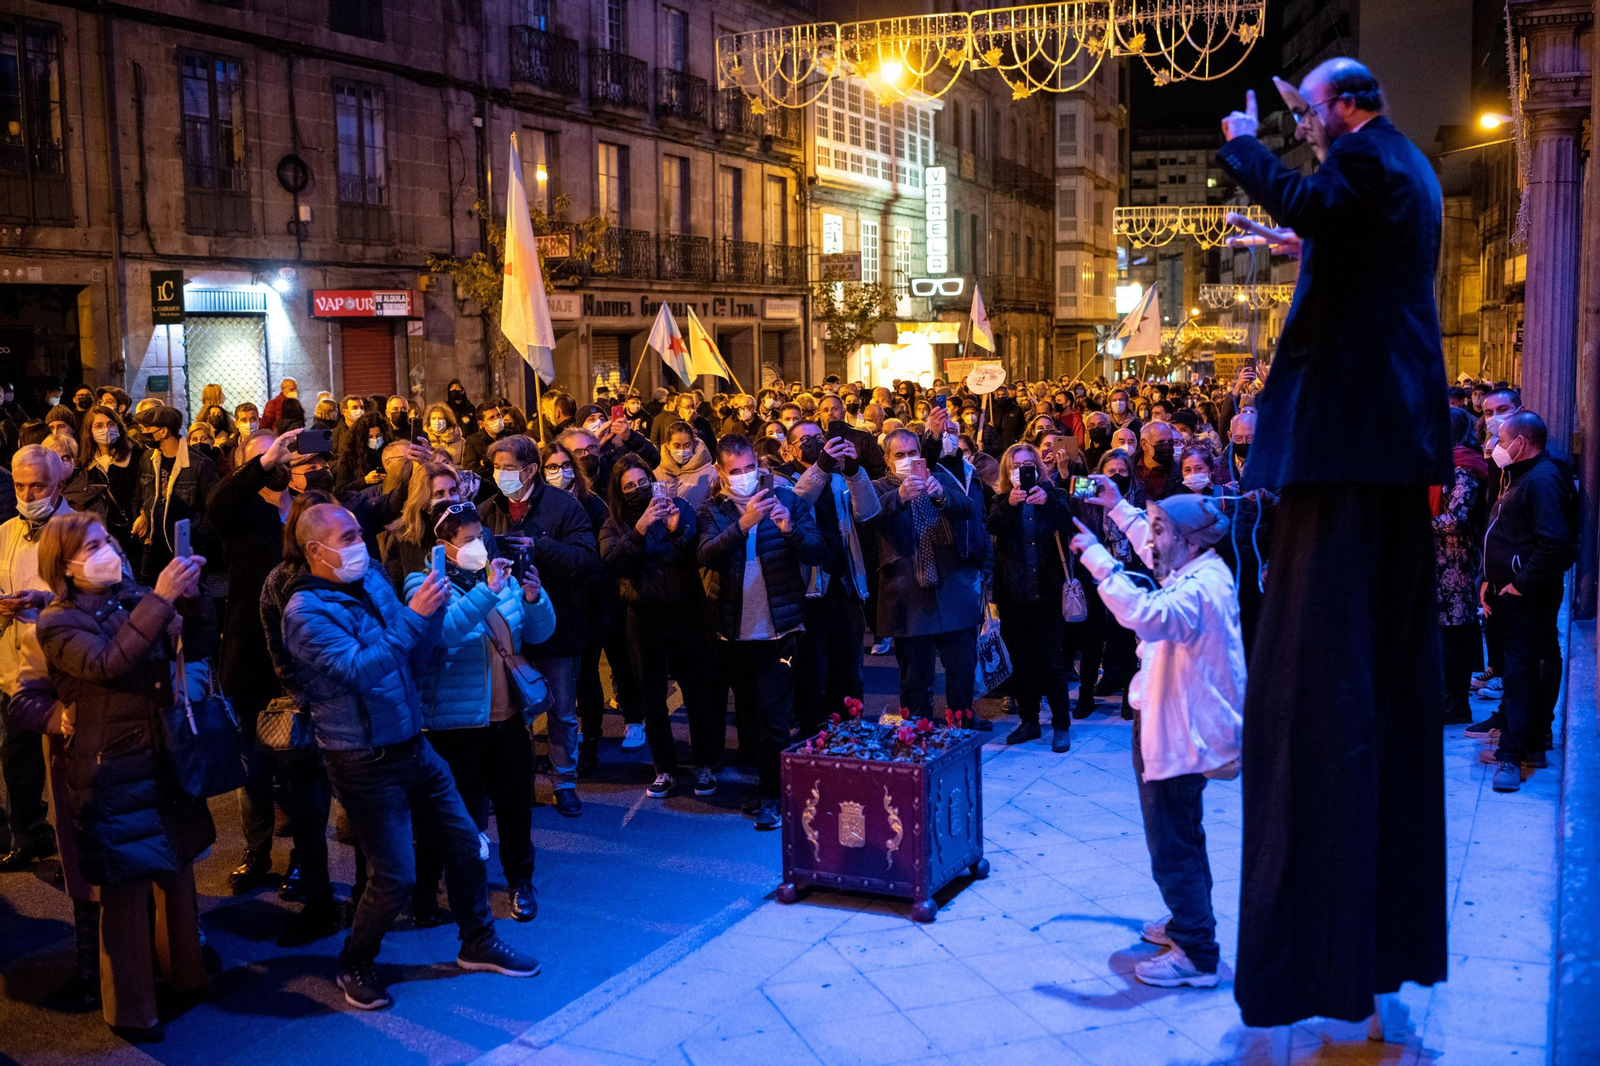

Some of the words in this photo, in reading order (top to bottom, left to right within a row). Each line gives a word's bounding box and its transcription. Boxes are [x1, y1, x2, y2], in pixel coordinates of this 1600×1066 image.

[931, 170, 942, 269] VARELA
[383, 295, 406, 303] ALQUILA
[547, 299, 573, 313] NAJE
